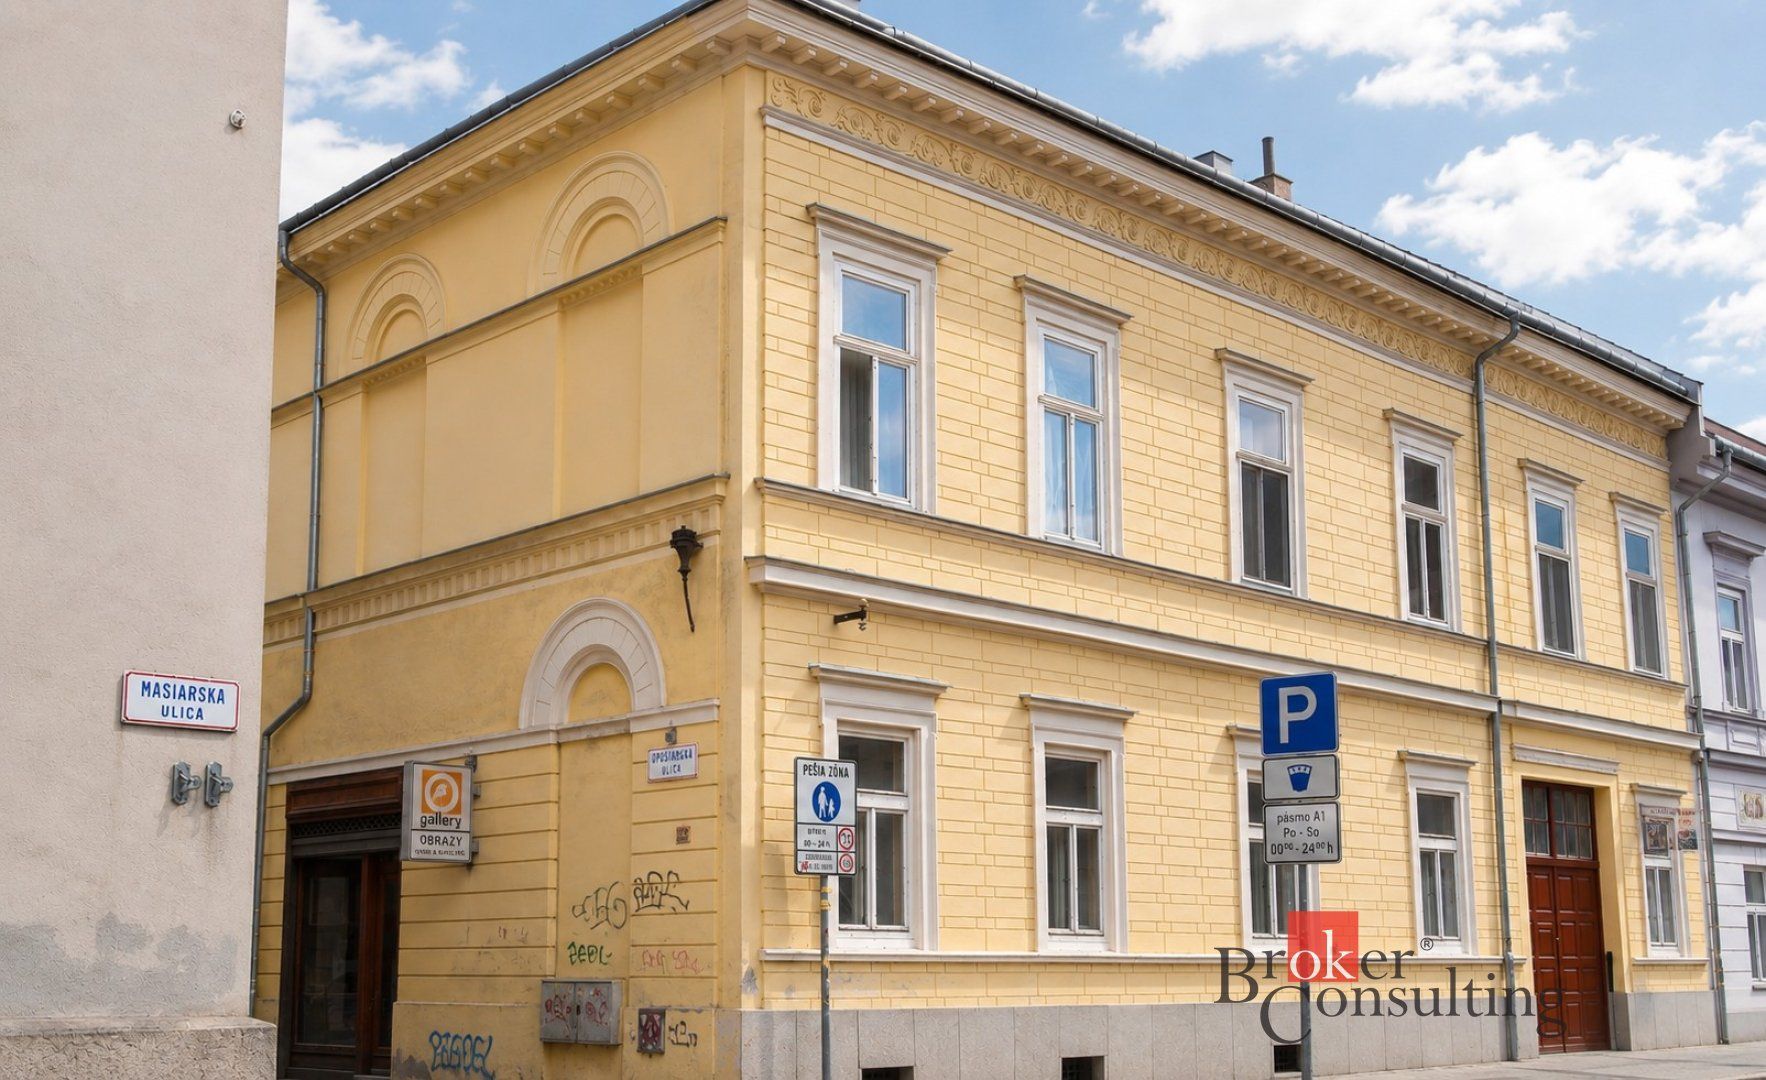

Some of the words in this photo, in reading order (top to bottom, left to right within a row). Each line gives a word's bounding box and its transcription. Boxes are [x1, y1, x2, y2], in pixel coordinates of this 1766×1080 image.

[141, 681, 225, 704] MASIARSKA
[161, 705, 204, 720] ULICA
[1279, 685, 1317, 744] P
[803, 762, 826, 777] PEŠIA
[420, 812, 462, 829] gallery
[1277, 811, 1310, 825] pásmo
[1313, 811, 1325, 821] A1
[1283, 827, 1296, 838] Po
[1306, 826, 1319, 837] So
[420, 834, 463, 847] OBRAZY
[1327, 841, 1333, 854] h
